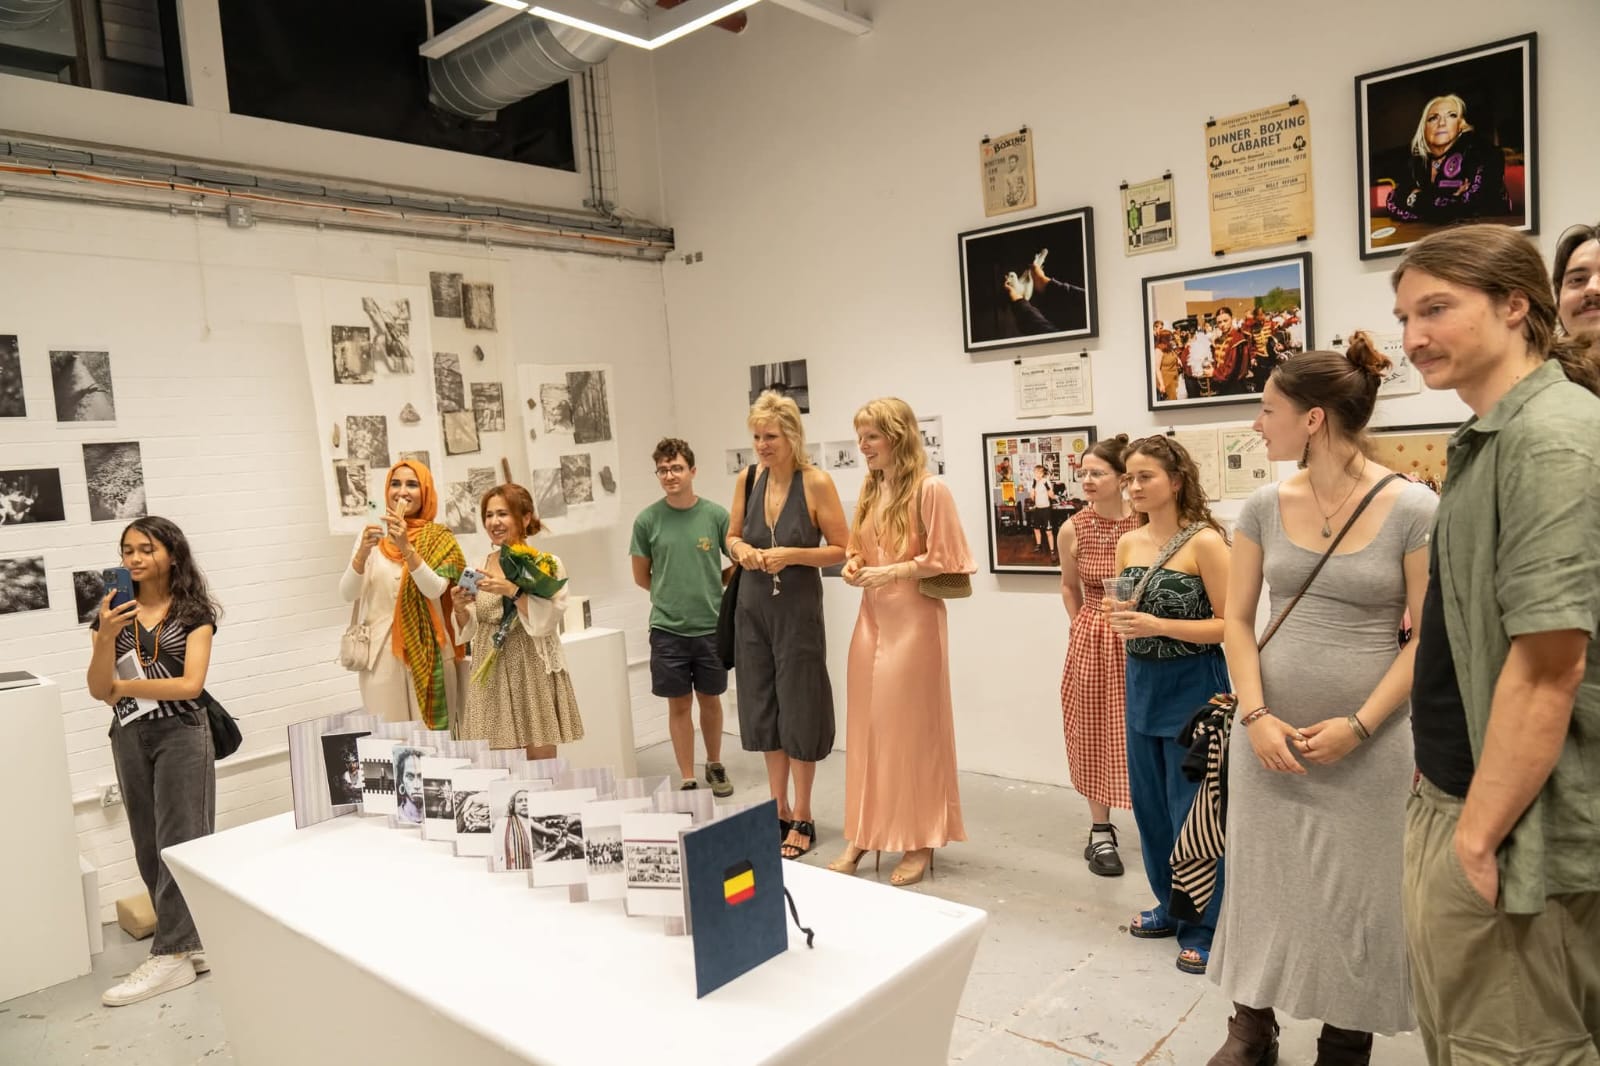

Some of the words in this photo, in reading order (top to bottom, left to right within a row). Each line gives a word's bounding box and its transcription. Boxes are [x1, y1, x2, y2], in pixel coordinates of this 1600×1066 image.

[1209, 128, 1251, 147] DINNER
[1260, 115, 1305, 135] BOXING
[993, 135, 1026, 153] BOXING
[1231, 133, 1281, 153] CABARET
